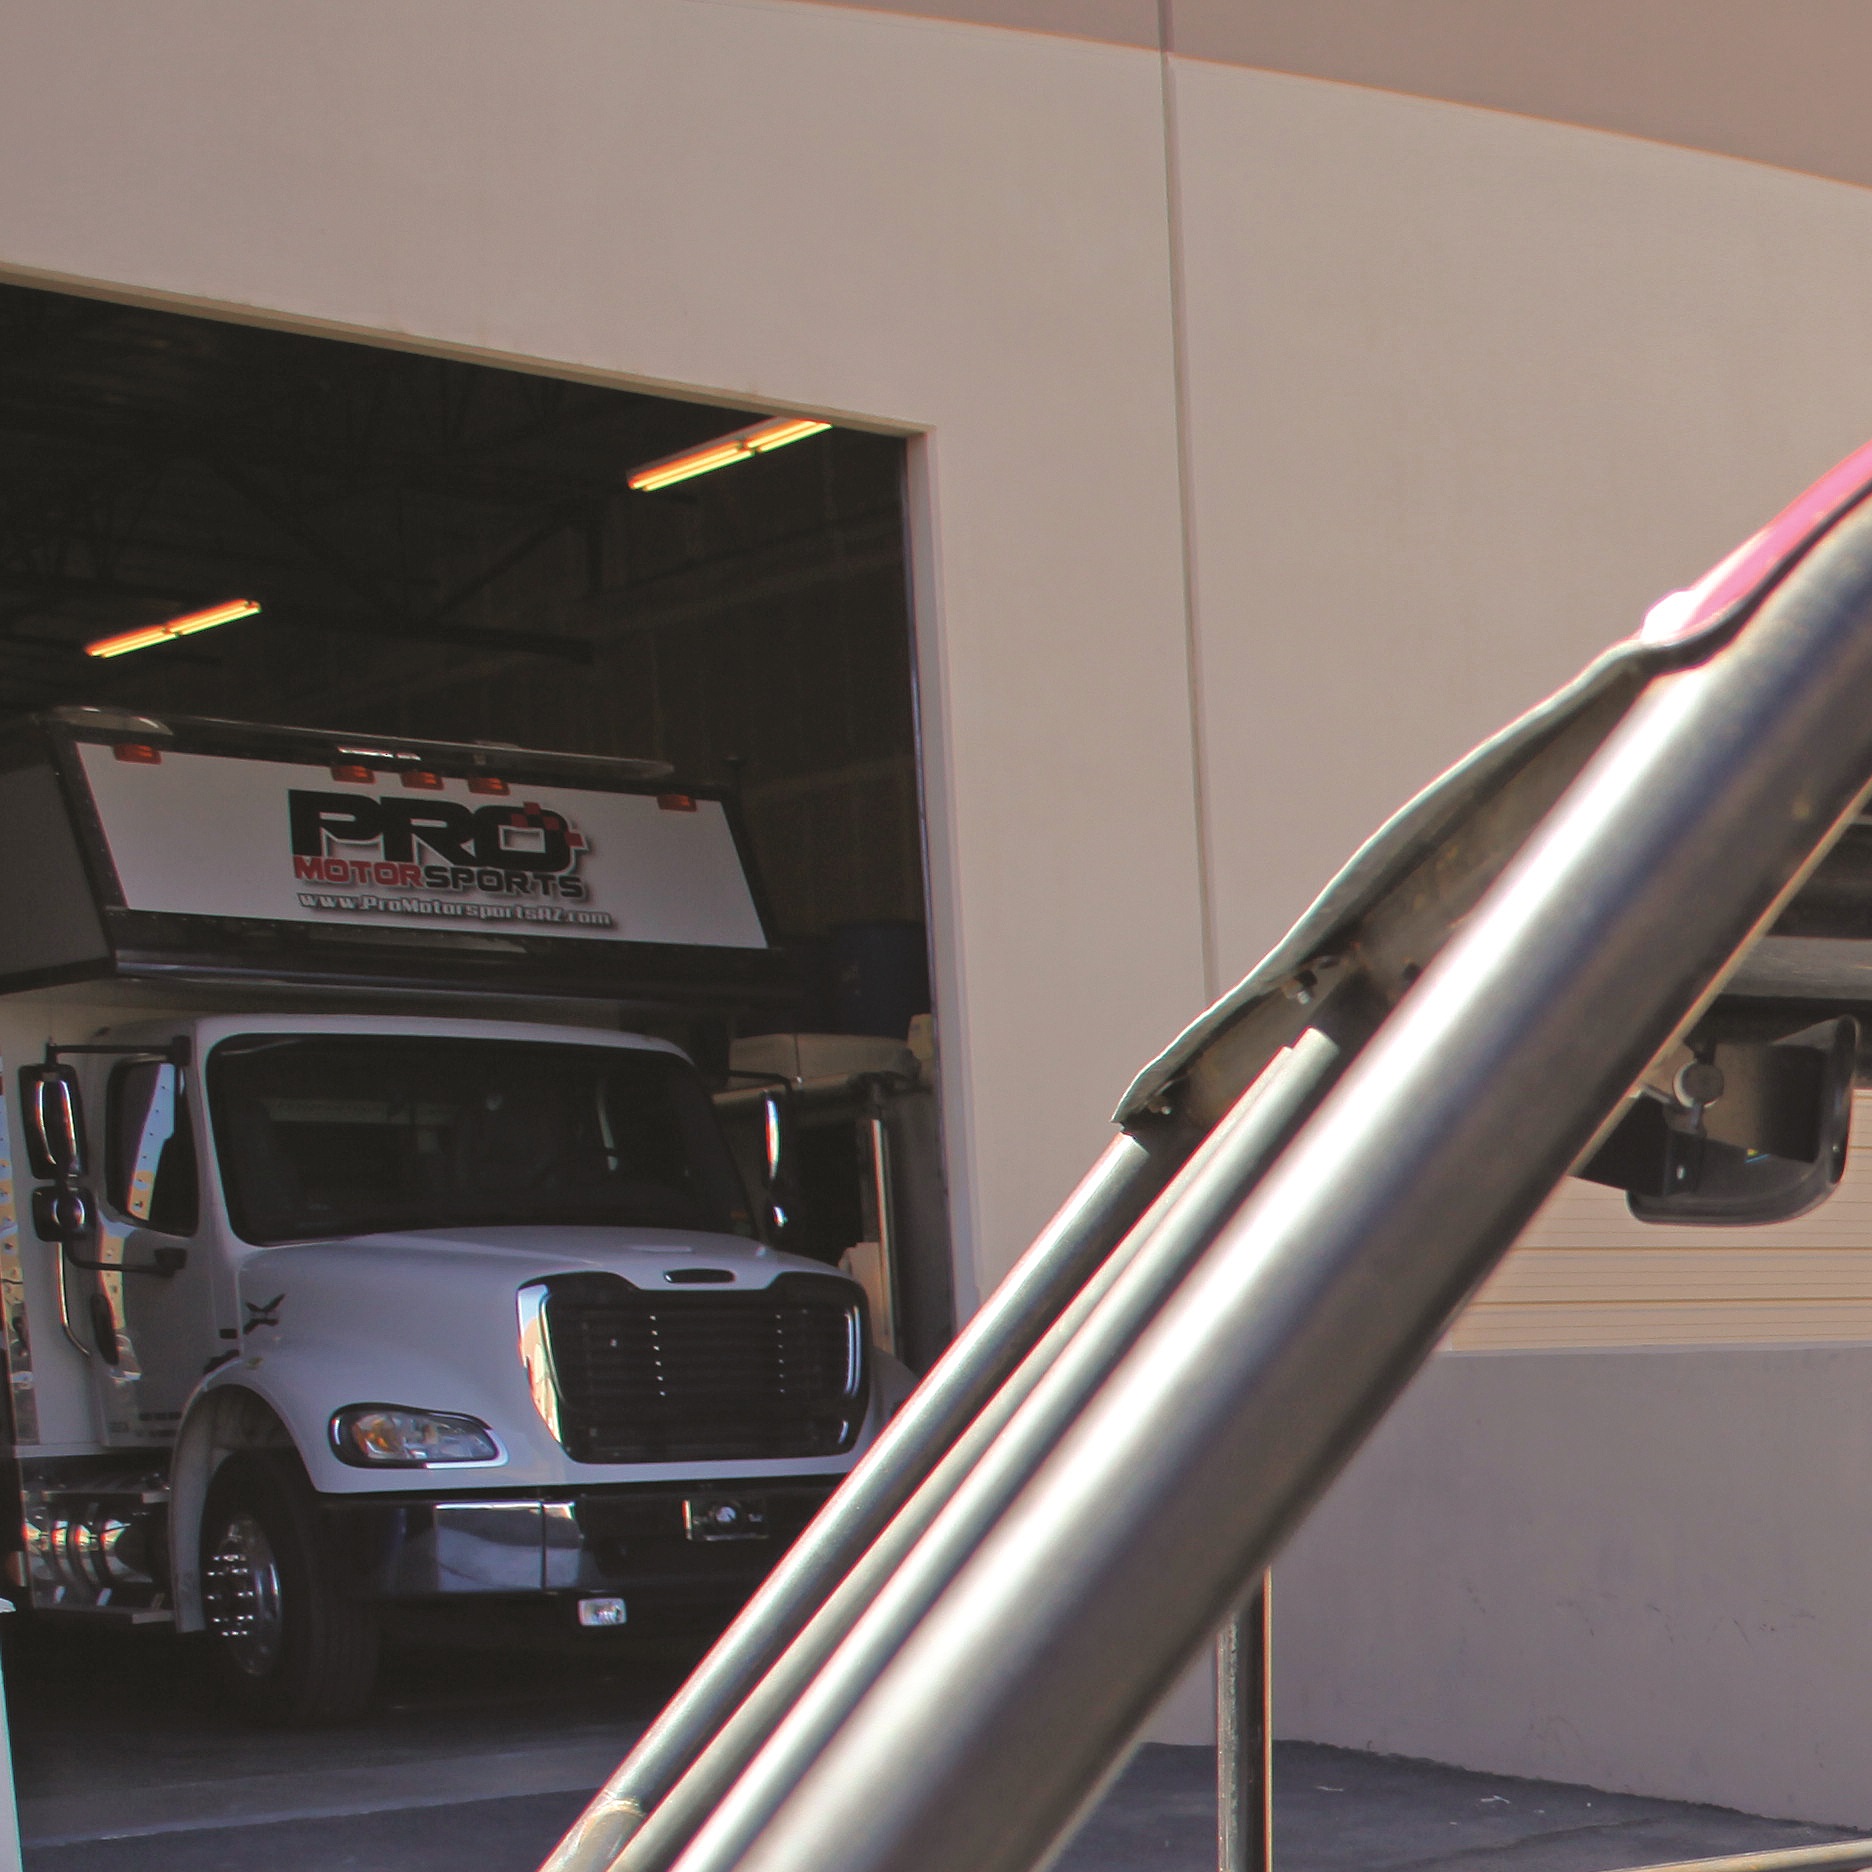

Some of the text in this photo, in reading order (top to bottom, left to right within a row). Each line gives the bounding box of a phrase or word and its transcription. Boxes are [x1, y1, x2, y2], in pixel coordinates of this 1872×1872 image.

[288, 789, 584, 873] PRO
[292, 855, 584, 898] MOTORSPORTS
[297, 892, 613, 926] www.ProMotorsportsAZ.com
